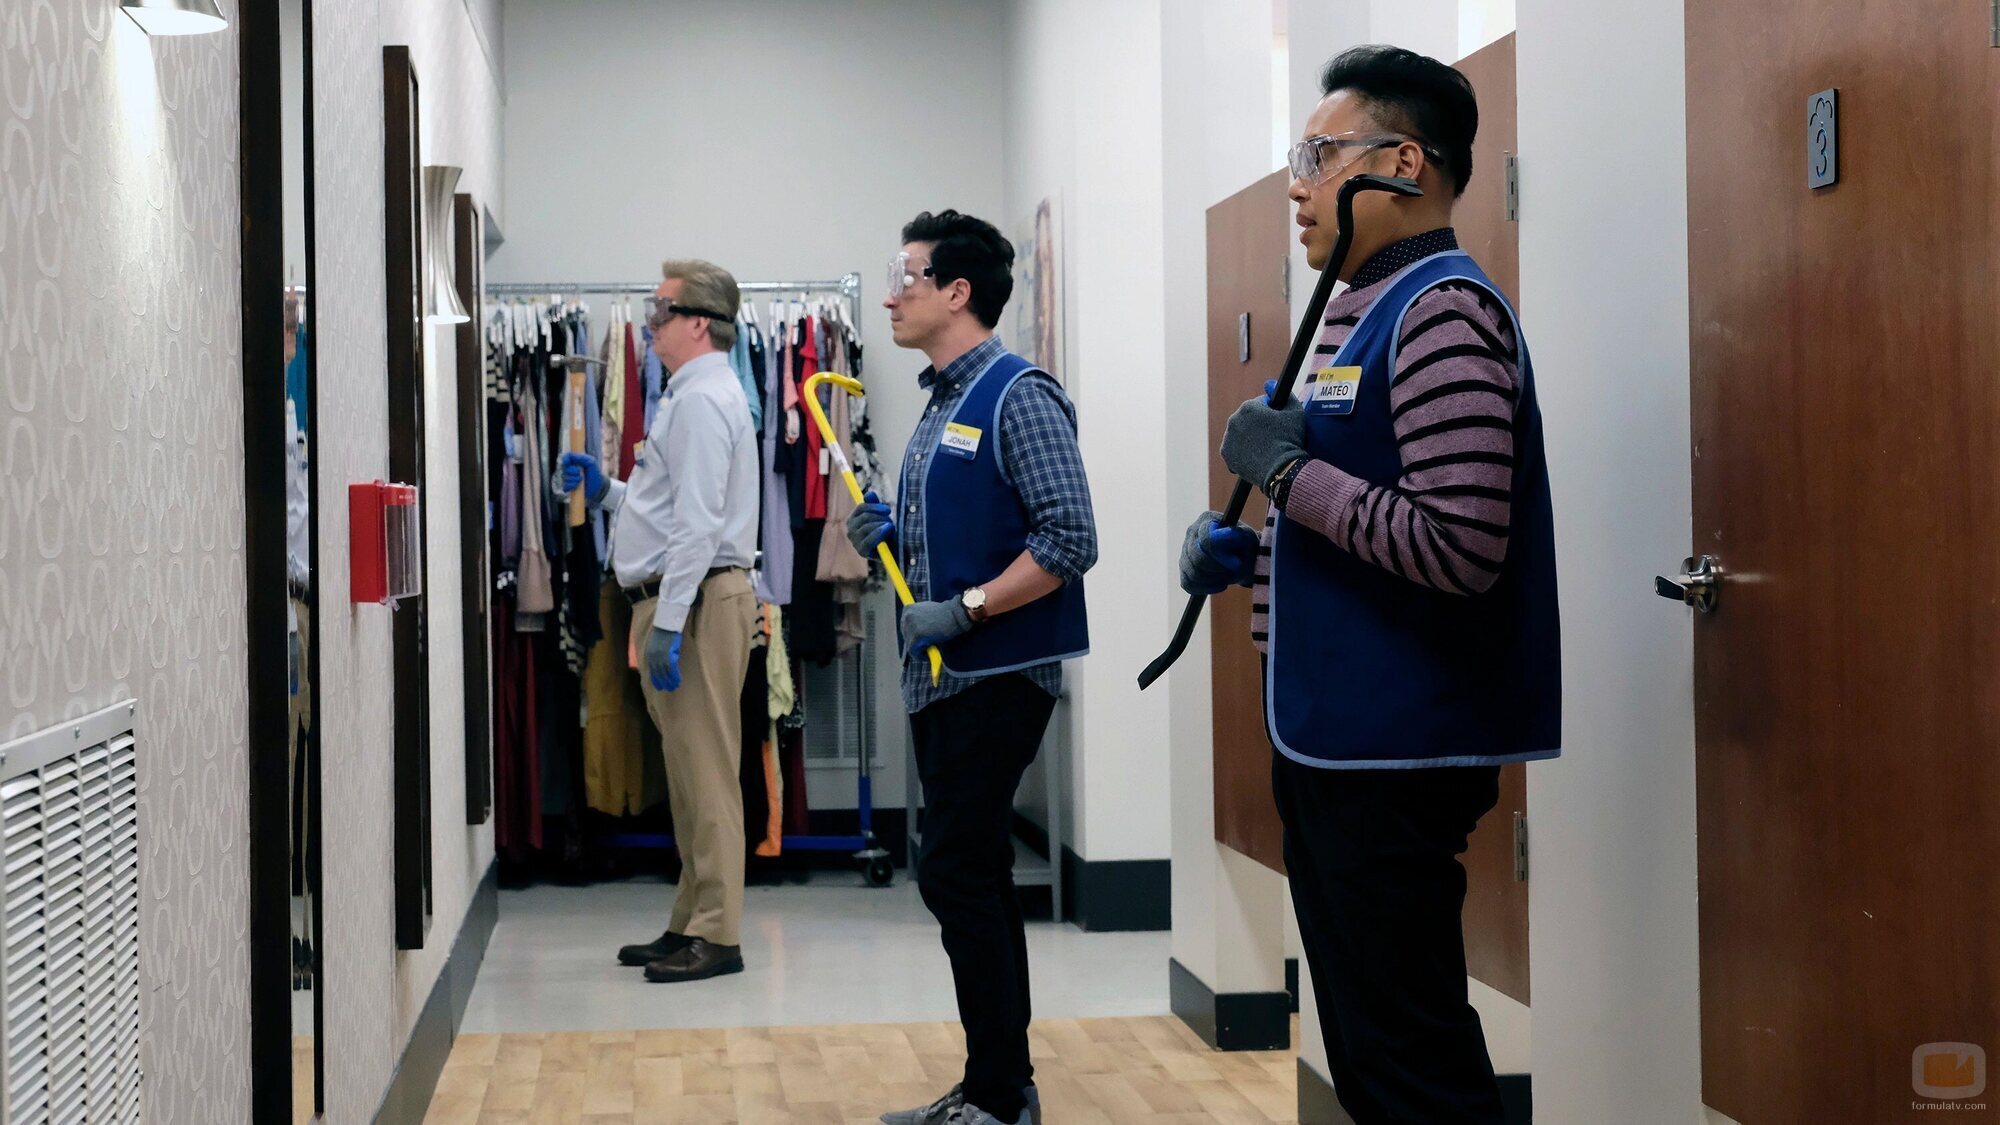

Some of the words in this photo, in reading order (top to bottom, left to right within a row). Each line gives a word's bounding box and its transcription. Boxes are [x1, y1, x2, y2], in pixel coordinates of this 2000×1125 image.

[1816, 129, 1827, 177] 3
[1320, 385, 1349, 397] MATEO
[948, 436, 971, 447] JONAH
